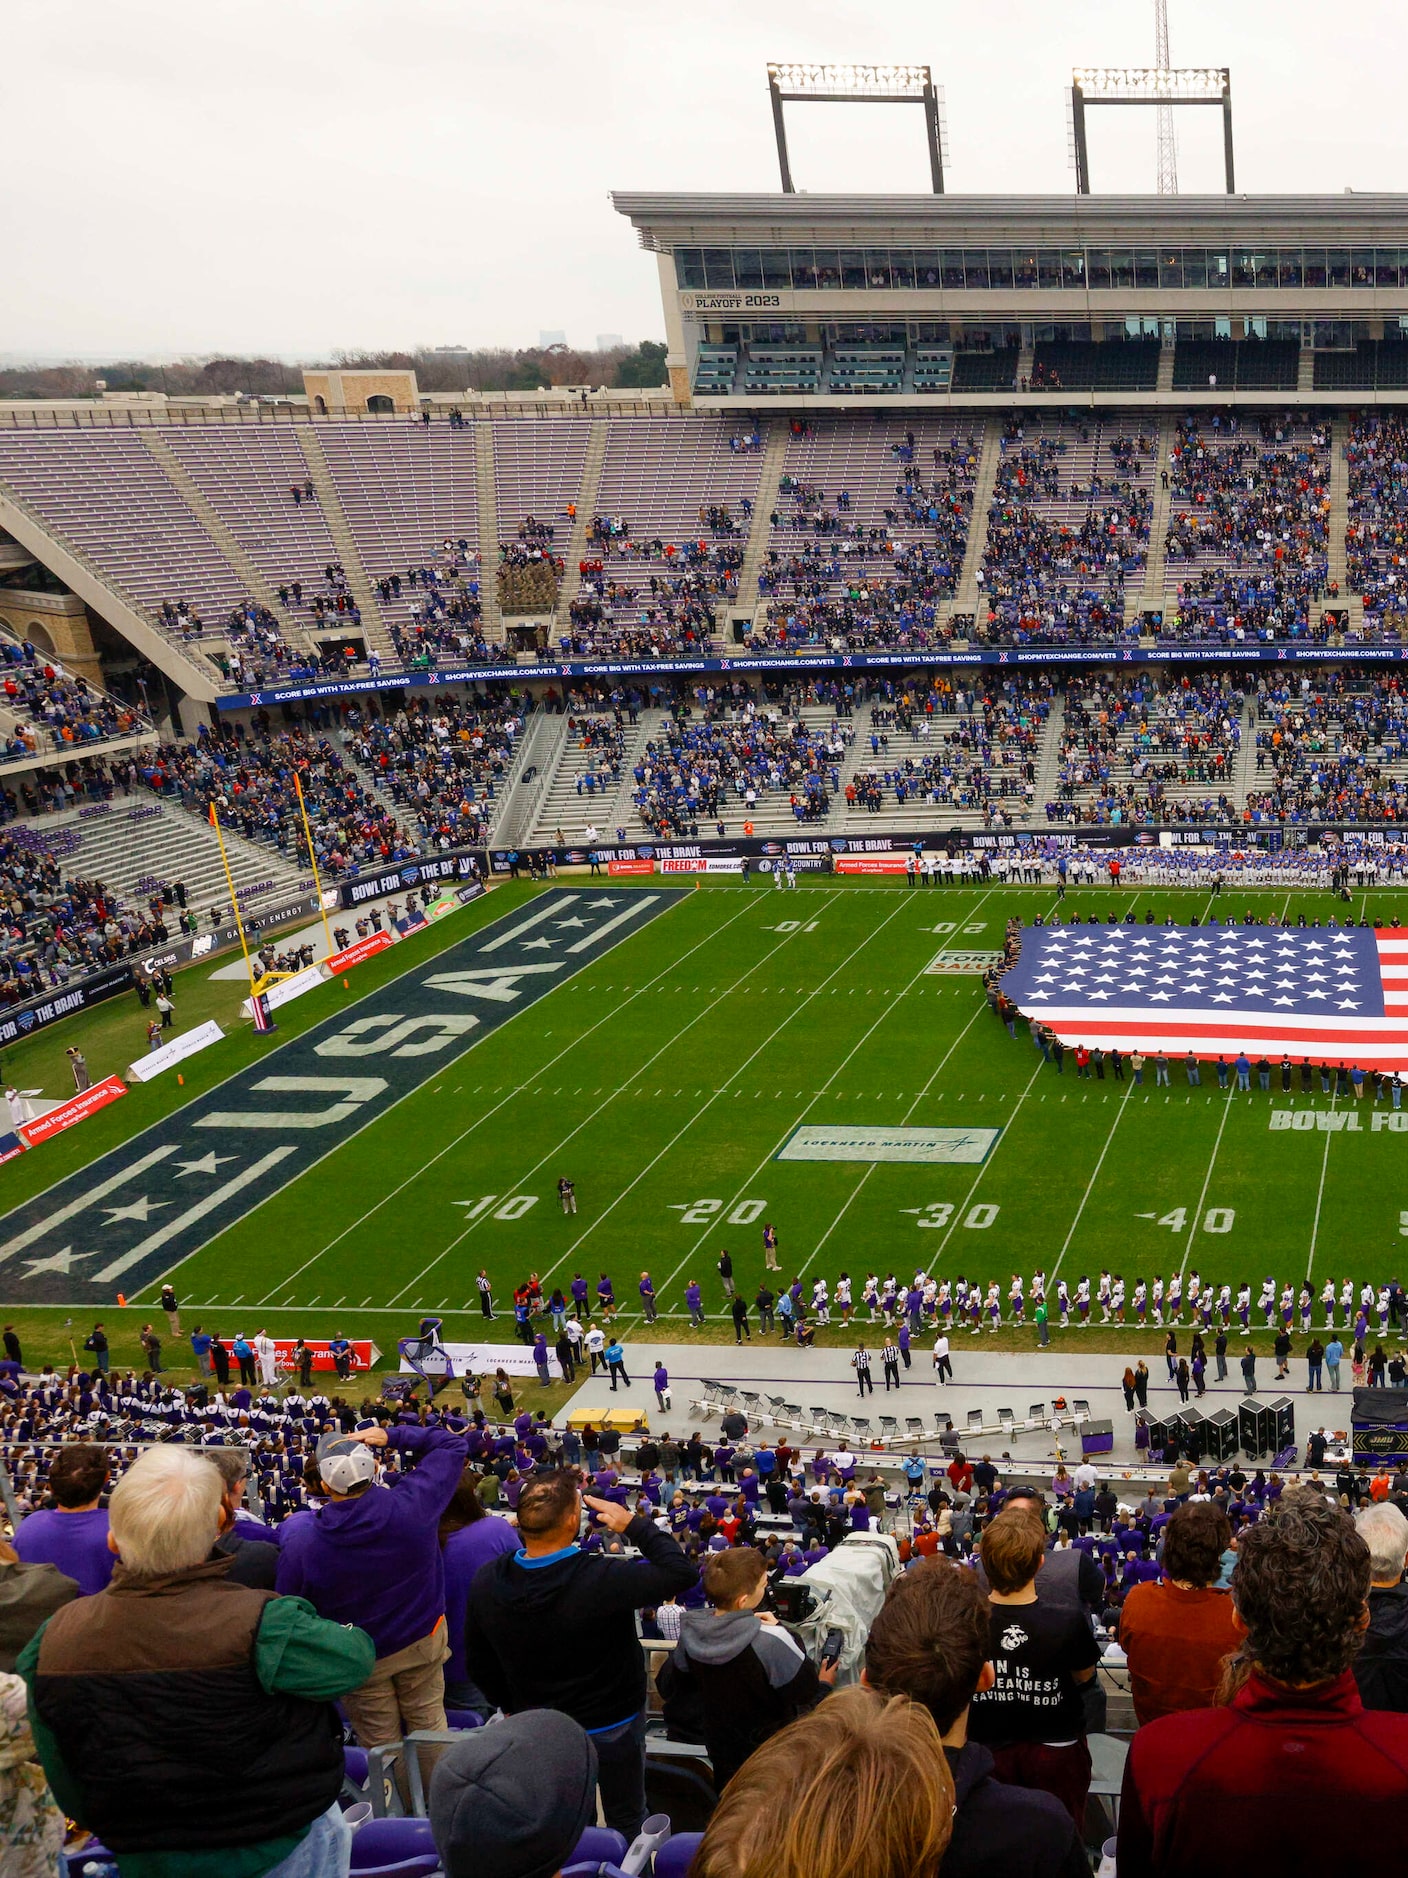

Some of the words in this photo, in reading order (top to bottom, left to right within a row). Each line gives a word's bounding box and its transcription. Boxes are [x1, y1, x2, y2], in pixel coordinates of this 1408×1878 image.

[696, 299, 742, 308] PLAYOFF
[745, 295, 780, 307] 2023
[1017, 652, 1117, 661] SHOPMYEXCHANGE.COM/VETS
[1148, 651, 1170, 659] SCORE
[584, 665, 608, 673] SCORE
[622, 664, 640, 672] WITH
[642, 663, 674, 671] TAX-FREE
[675, 662, 704, 670] SAVINGS
[733, 658, 835, 668] SHOPMYEXCHANGE.COM/VETS
[445, 667, 557, 681] SHOPMYEXCHANGE.COM/VETS
[275, 689, 301, 700] SCORE
[303, 688, 316, 697] BIG
[317, 686, 338, 695] WITH
[339, 682, 376, 693] TAX-FREE
[377, 677, 410, 688] SAVINGS
[973, 836, 998, 847] BOWL
[998, 836, 1015, 846] FOR
[1184, 833, 1200, 844] FOR
[1368, 832, 1384, 843] FOR
[618, 849, 636, 860] FOR
[655, 847, 672, 859] THE
[673, 846, 701, 858] BRAVE
[786, 841, 811, 853] BOWL
[813, 841, 829, 853] FOR
[848, 840, 865, 852] THE
[866, 839, 892, 850] BRAVE
[662, 859, 707, 871] FREEDOM
[351, 880, 380, 902] BOWL
[381, 874, 400, 892] FOR
[419, 863, 440, 880] THE
[269, 905, 303, 924] ENERGY
[773, 920, 821, 933] 10
[931, 922, 988, 934] 20
[154, 953, 177, 968] CELSIUS
[330, 955, 345, 969] Armed
[344, 948, 360, 961] Forces
[359, 938, 381, 954] Insurance
[0, 1020, 18, 1042] FOR
[35, 1004, 55, 1024] THE
[54, 989, 85, 1015] BRAVE
[88, 982, 109, 996] LOCKHEED
[192, 962, 565, 1129] USA
[28, 1118, 51, 1138] Armed
[51, 1106, 77, 1125] Forces
[77, 1088, 109, 1111] Insurance
[1269, 1110, 1364, 1132] BOWL
[803, 1138, 876, 1148] LOCKHEED
[881, 1139, 936, 1149] MARTIN
[464, 1195, 539, 1221] 10
[679, 1199, 768, 1225] 20
[916, 1202, 1001, 1229] 30
[1157, 1207, 1236, 1233] 40
[1370, 1436, 1395, 1444] JMU
[674, 1509, 687, 1524] 22
[1015, 1666, 1030, 1679] IS
[991, 1677, 1059, 1692] EAKNESS
[972, 1690, 1014, 1702] EAVING
[1016, 1691, 1031, 1702] THE
[1033, 1691, 1064, 1706] BODY.
